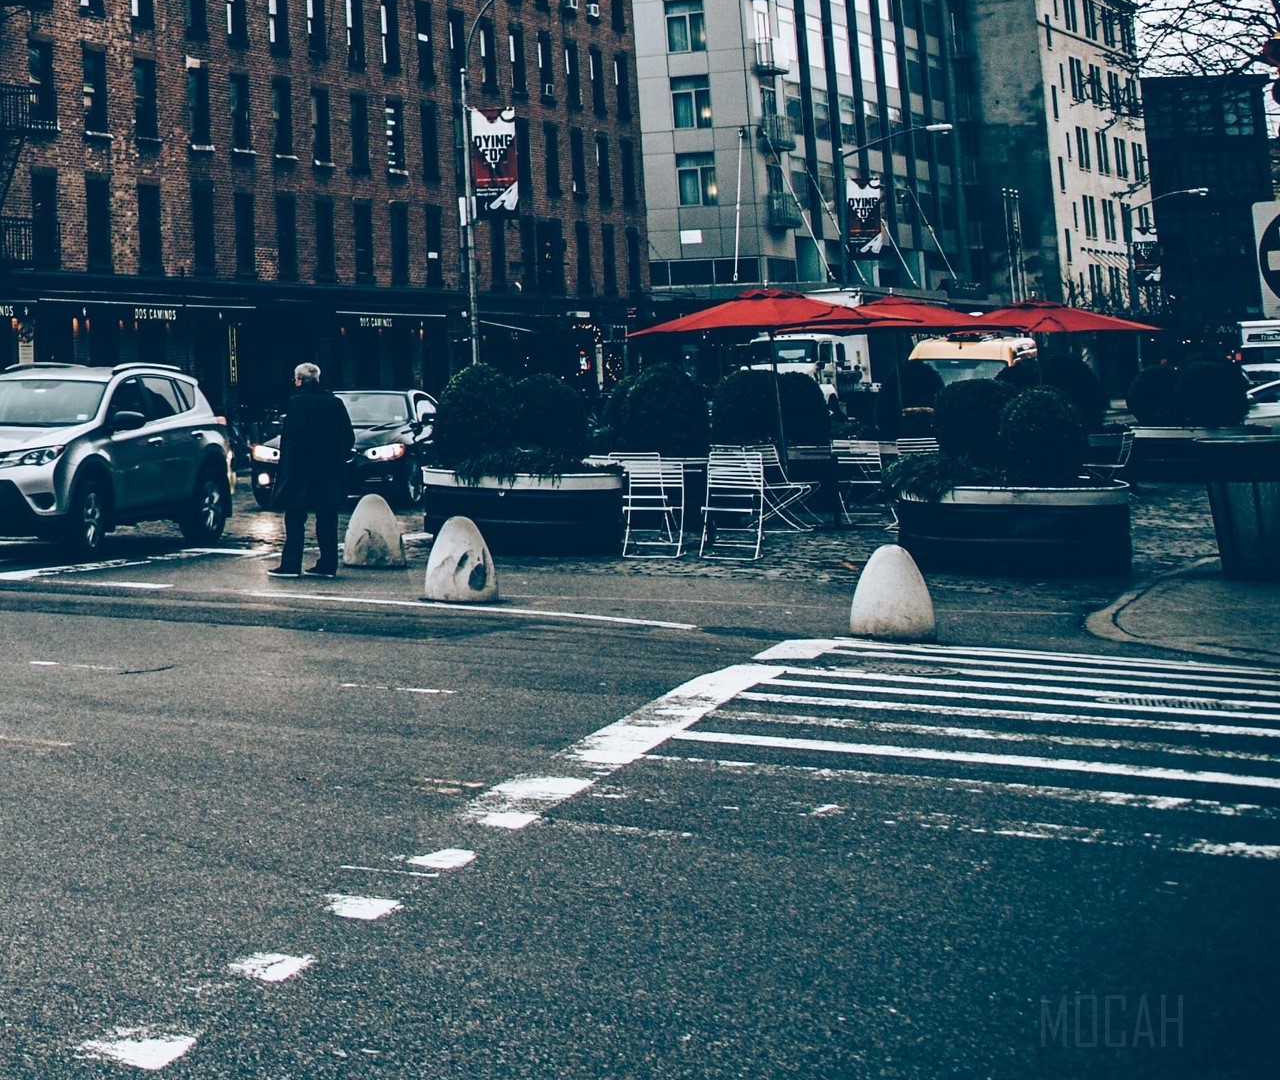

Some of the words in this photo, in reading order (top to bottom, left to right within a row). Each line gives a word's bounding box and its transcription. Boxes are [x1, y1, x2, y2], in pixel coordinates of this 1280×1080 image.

[474, 134, 513, 149] DYING
[134, 308, 147, 319] DOS
[149, 308, 176, 320] CAMINOS
